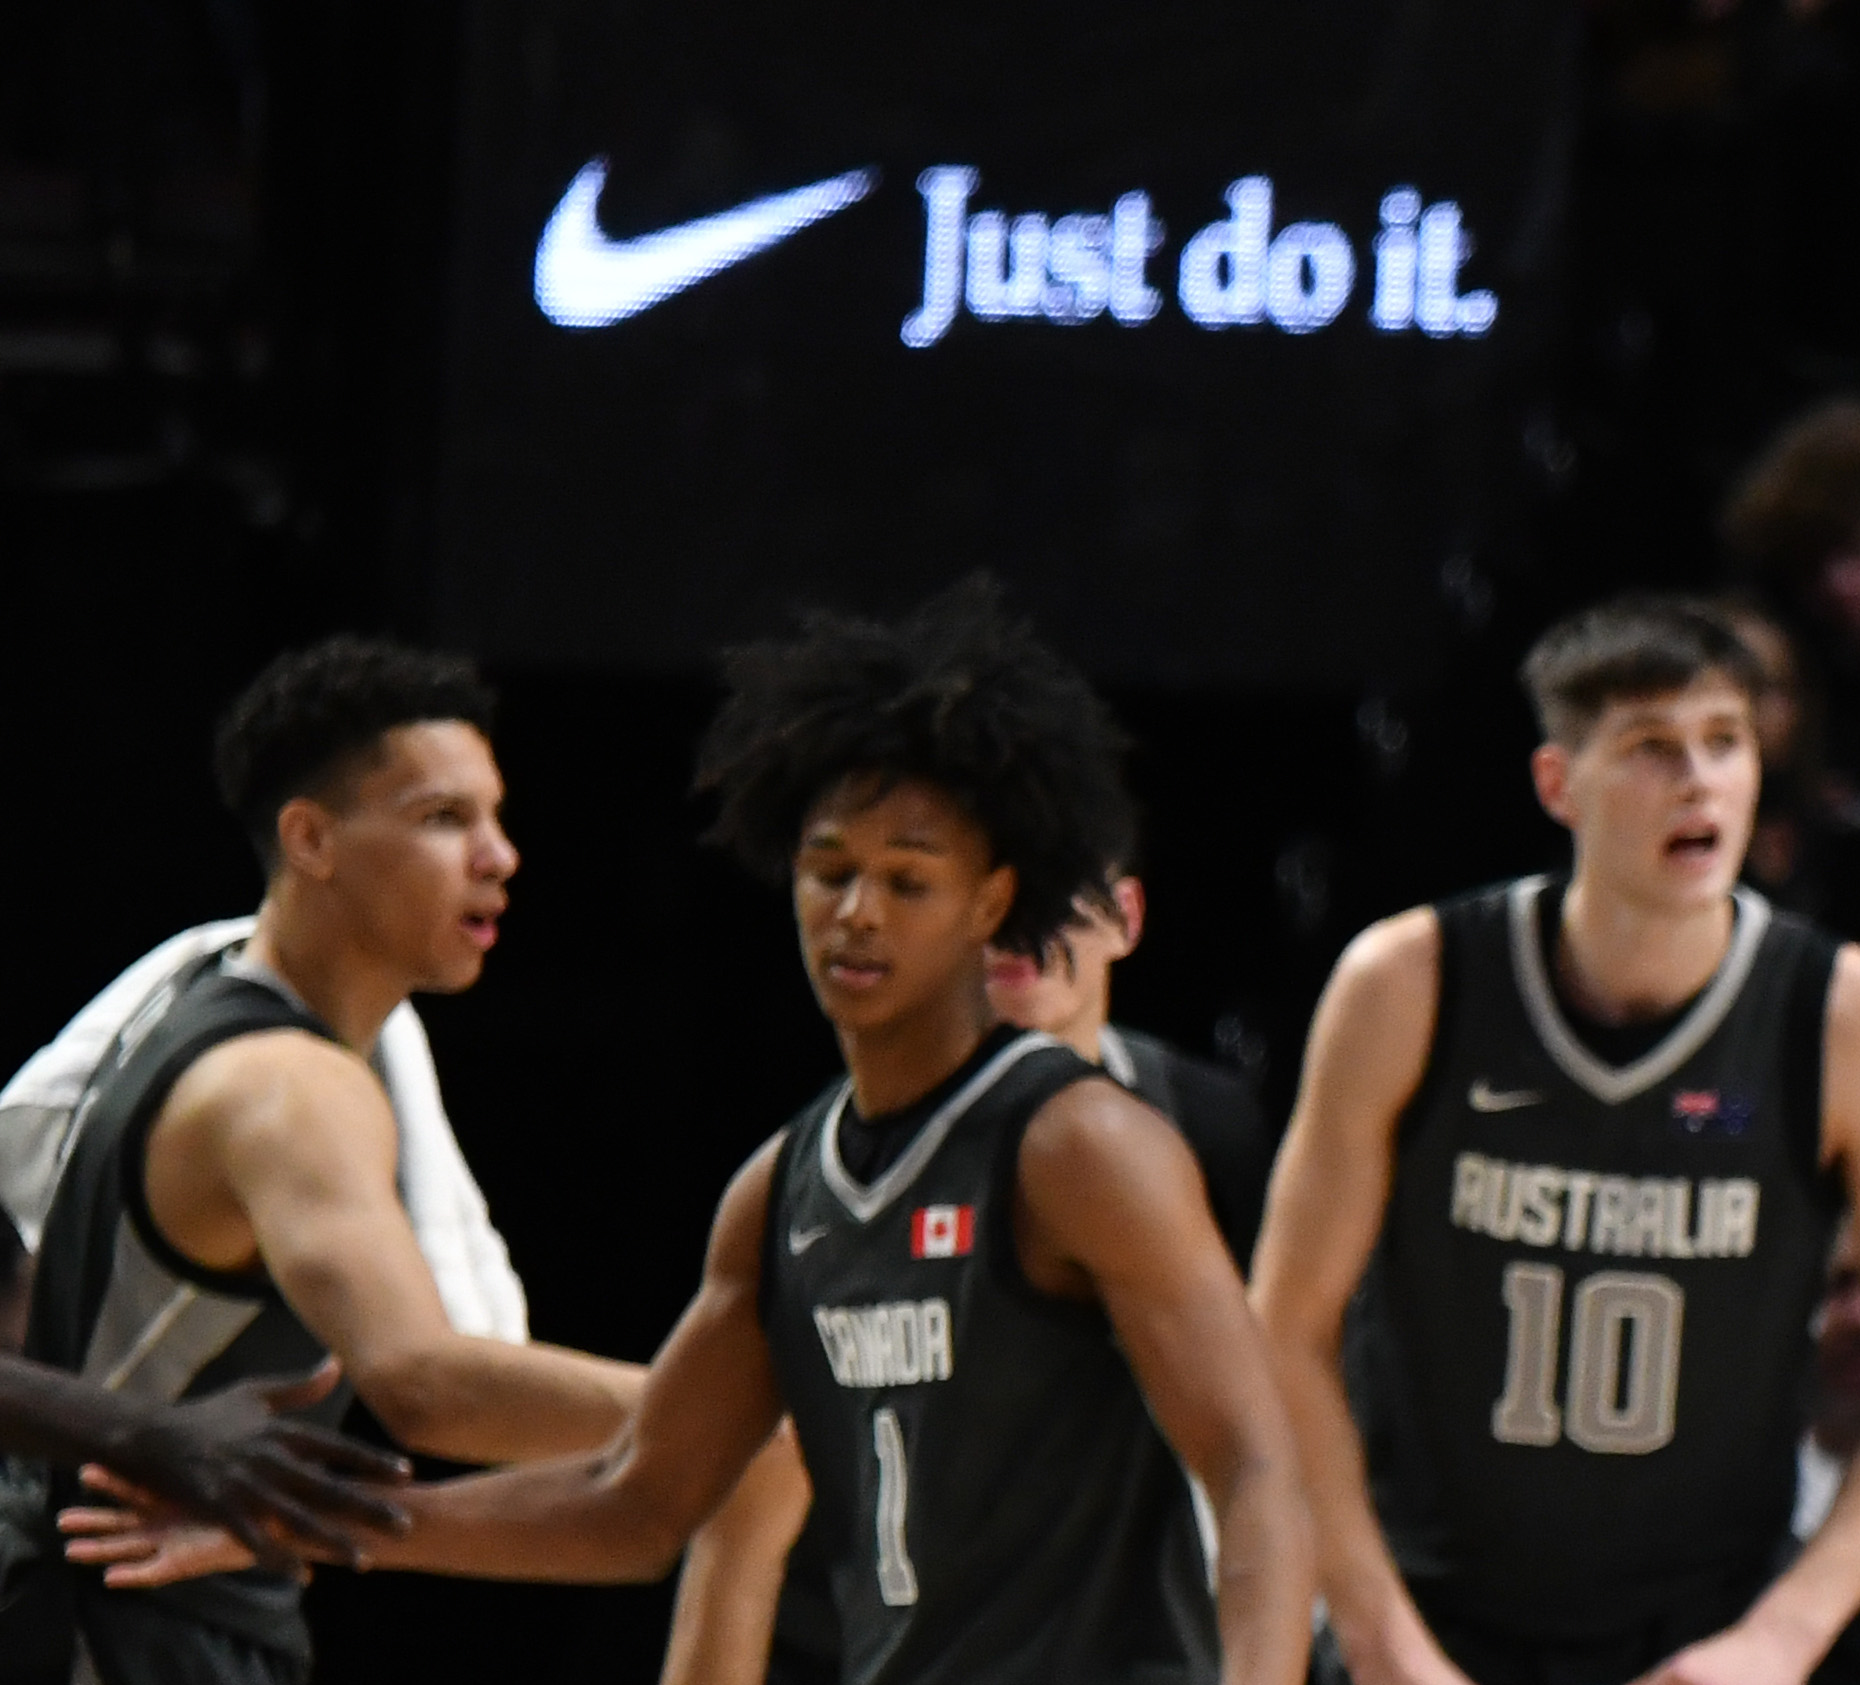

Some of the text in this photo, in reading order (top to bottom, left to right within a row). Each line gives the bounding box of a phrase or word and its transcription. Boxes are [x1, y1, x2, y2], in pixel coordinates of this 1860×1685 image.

[900, 165, 1498, 347] Just do it.
[1450, 1150, 1760, 1260] AUSTRALIA
[813, 1299, 954, 1388] CANADA
[1490, 1261, 1685, 1455] 10
[873, 1407, 918, 1606] 1
